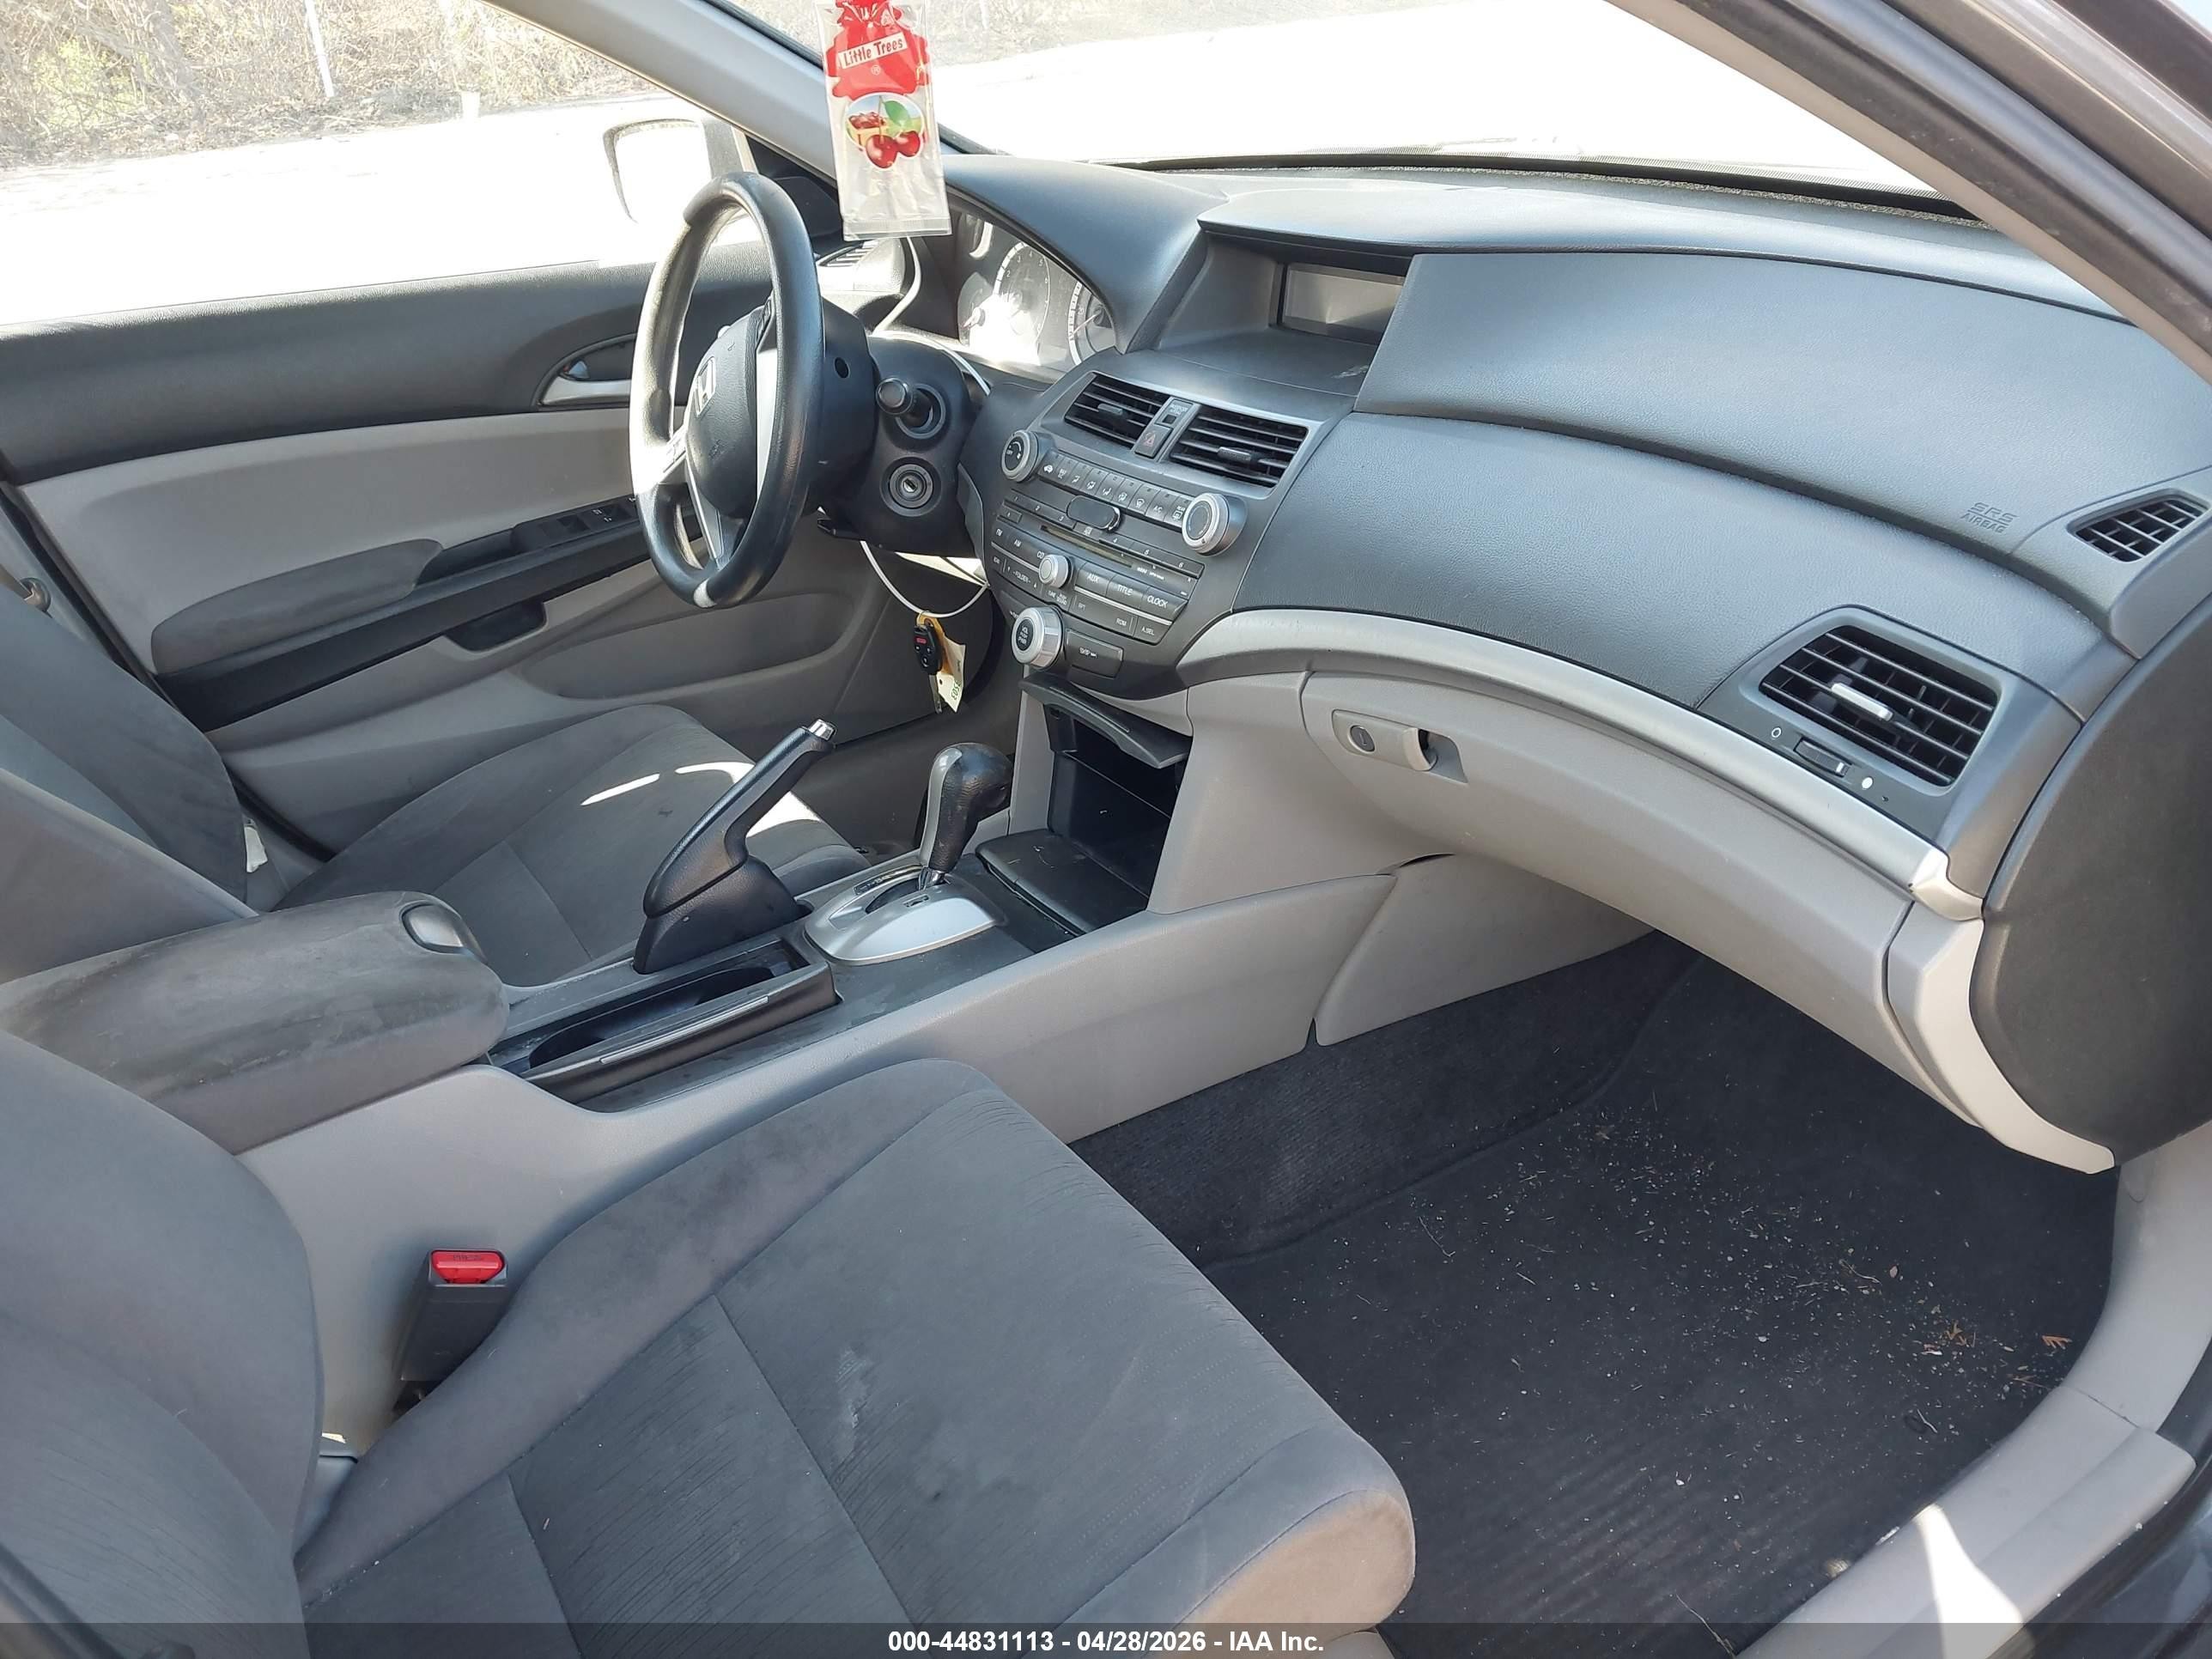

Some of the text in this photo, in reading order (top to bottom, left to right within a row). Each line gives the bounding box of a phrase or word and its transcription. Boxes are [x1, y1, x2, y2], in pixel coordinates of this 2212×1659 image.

[843, 39, 903, 66] Little Trees
[1970, 501, 2020, 523] SRS
[1960, 513, 2008, 533] AIRBAG
[1036, 550, 1045, 559] CD
[1087, 573, 1100, 583] AUX
[1117, 584, 1133, 596] TITLE
[1146, 595, 1169, 608] CLOCK
